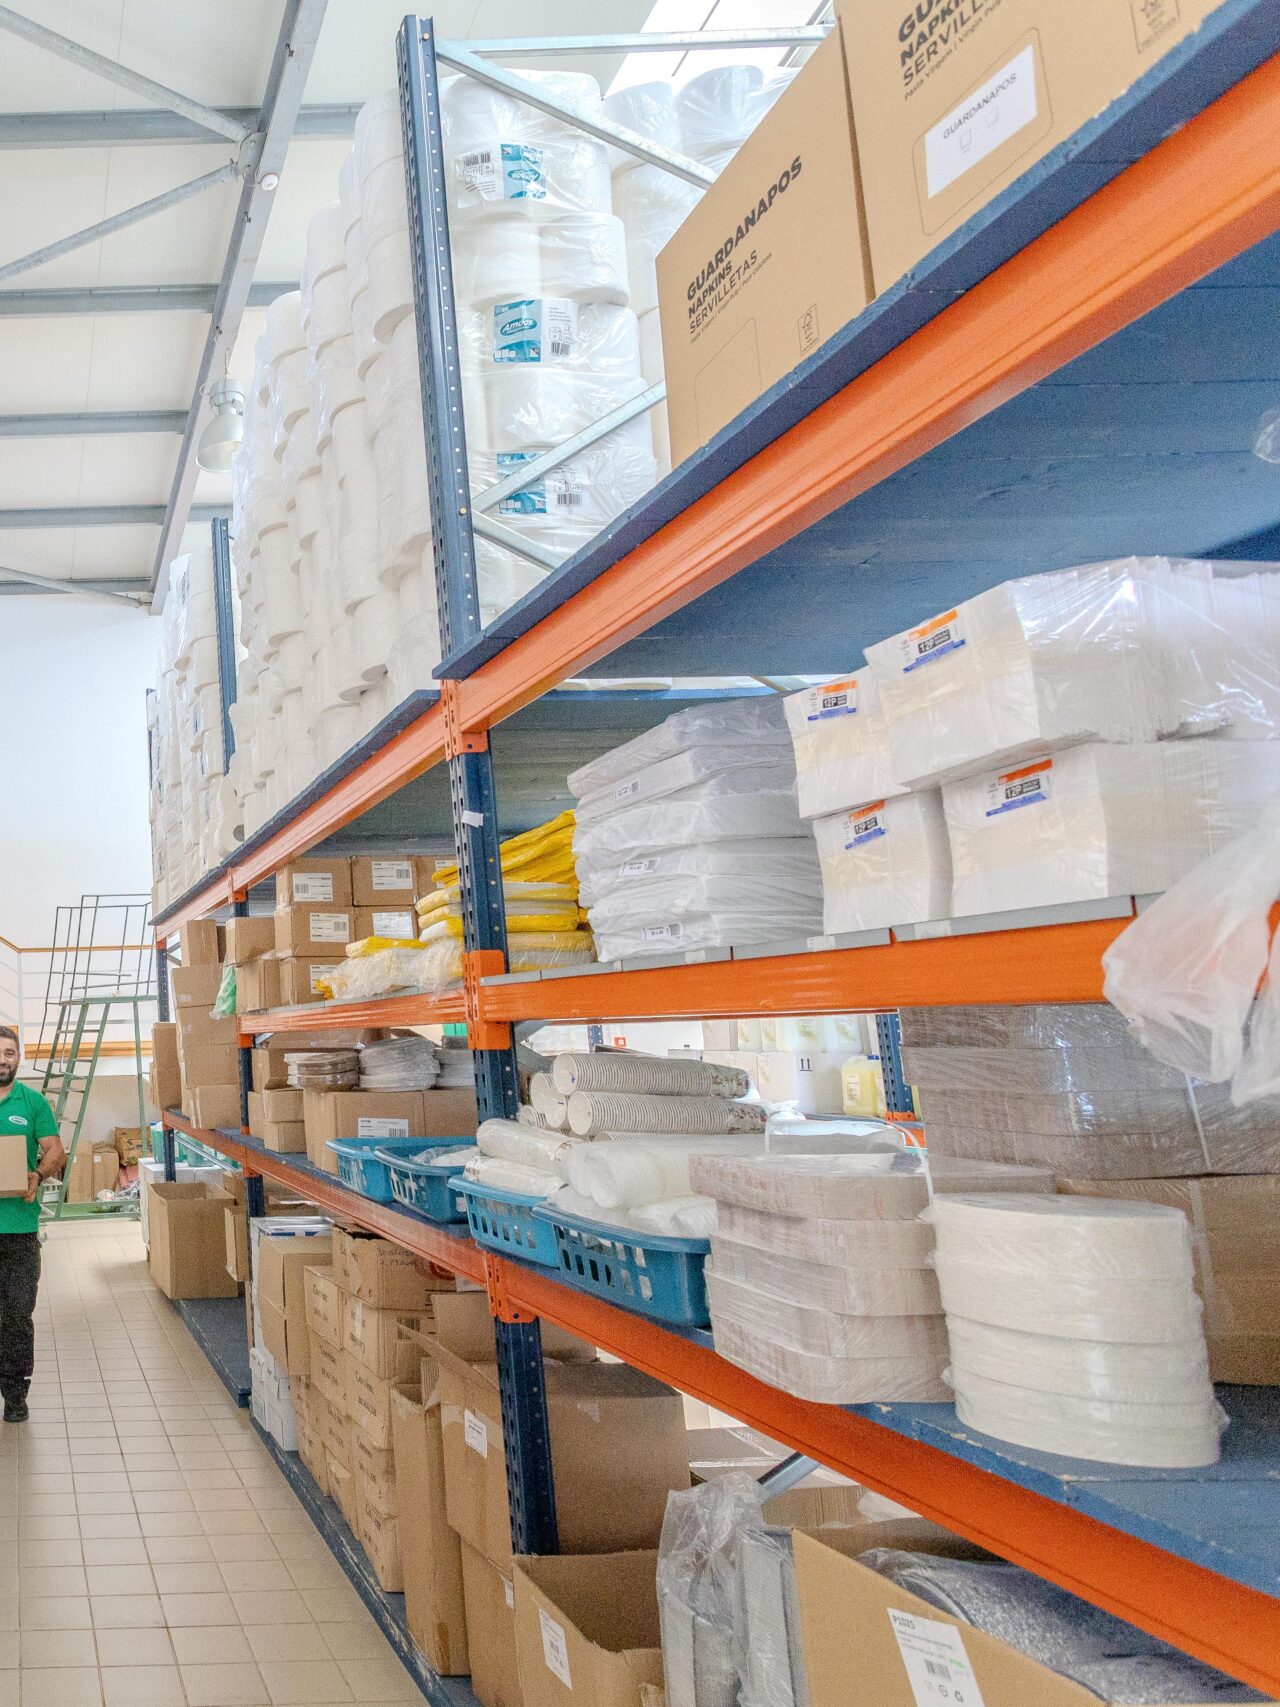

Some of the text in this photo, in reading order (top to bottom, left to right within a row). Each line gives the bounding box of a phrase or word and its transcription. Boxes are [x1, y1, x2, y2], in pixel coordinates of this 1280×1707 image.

[898, 0, 941, 42] GU
[901, 0, 966, 67] NAPKI
[904, 0, 989, 87] SERVILL
[943, 73, 1016, 139] GUARDANAPOS
[687, 155, 803, 301] GUARDANAPOS
[688, 260, 733, 320] NAPKINS
[690, 250, 758, 335] SERVILLETAS
[920, 639, 934, 652] 12P
[823, 696, 838, 708] 12P
[1006, 784, 1022, 798] 12P
